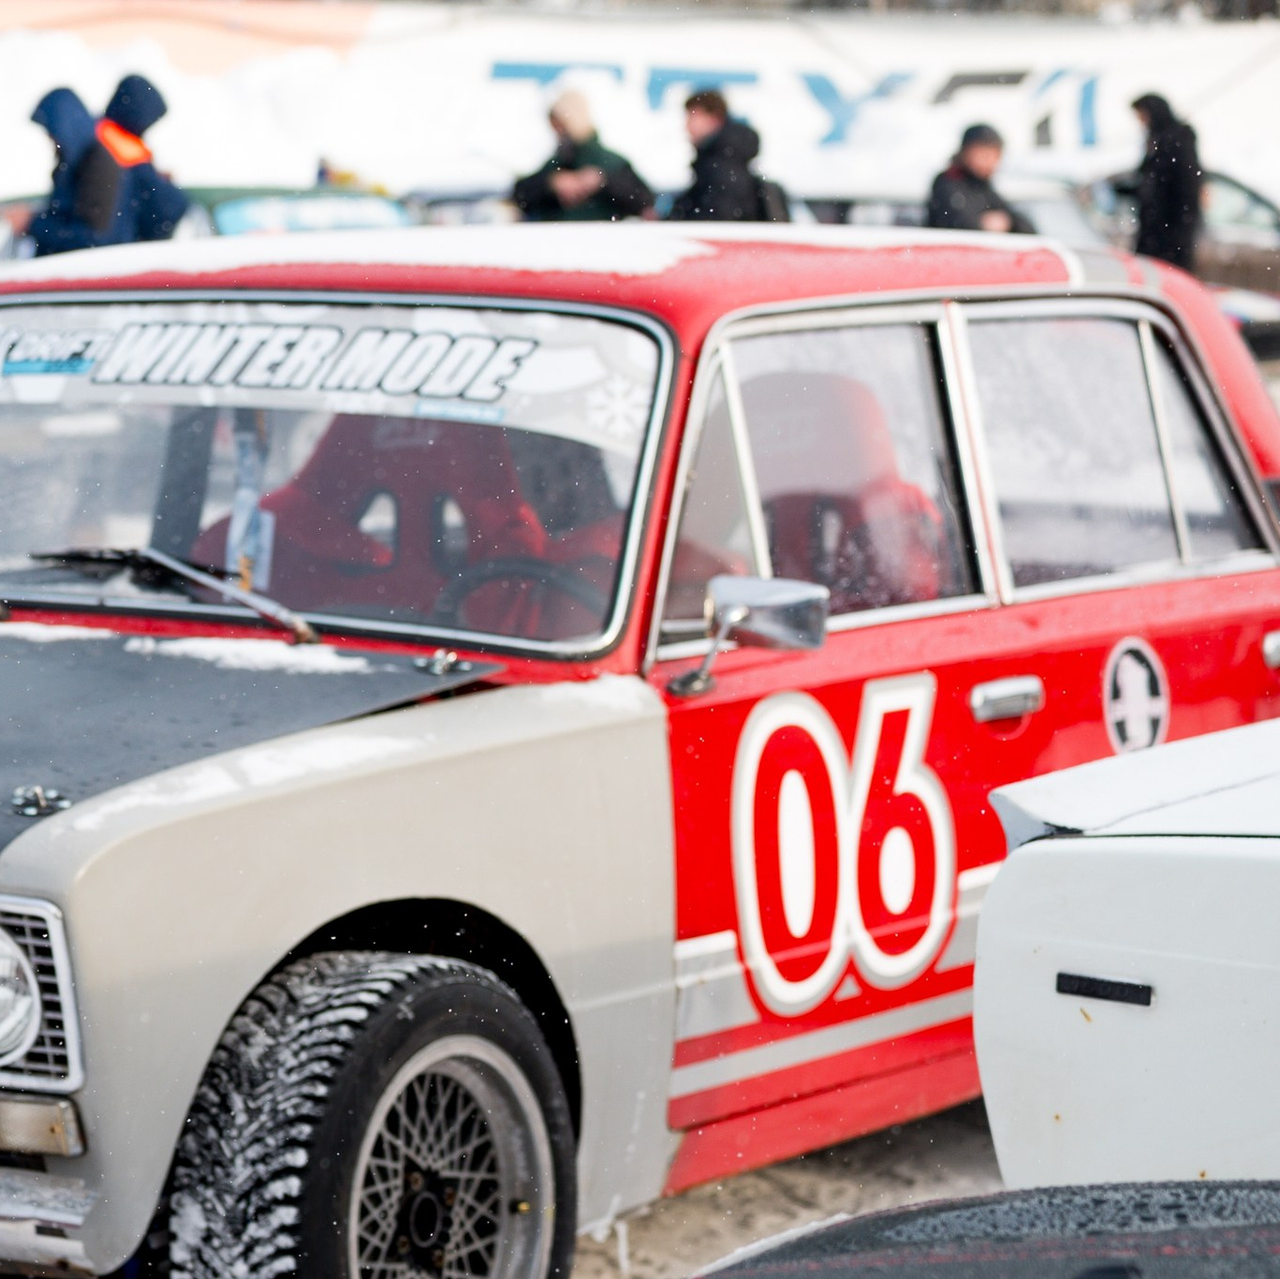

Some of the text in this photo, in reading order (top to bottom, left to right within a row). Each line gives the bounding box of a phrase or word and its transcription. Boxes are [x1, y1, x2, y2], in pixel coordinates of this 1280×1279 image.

[93, 324, 539, 402] WINTER MODE
[736, 675, 952, 1007] 06
